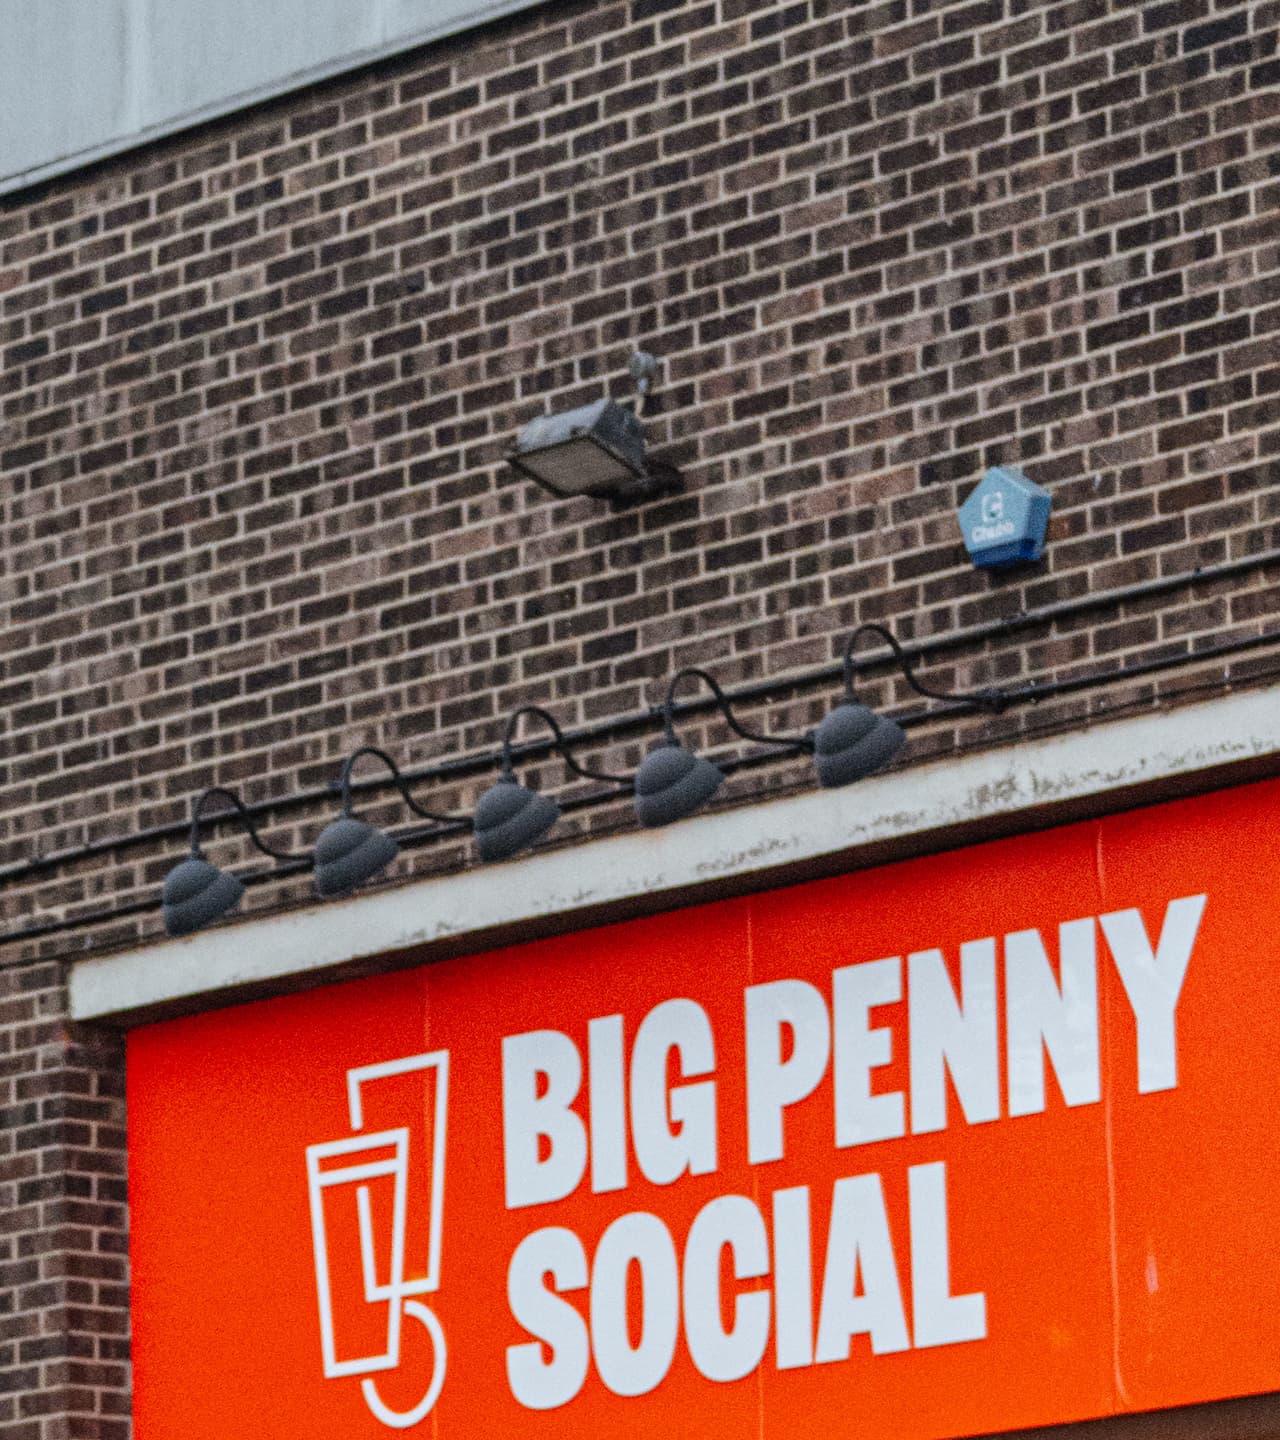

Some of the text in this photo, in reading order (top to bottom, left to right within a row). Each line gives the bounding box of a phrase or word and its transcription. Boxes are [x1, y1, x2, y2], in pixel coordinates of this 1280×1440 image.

[503, 895, 1206, 1208] BIG PENNY
[507, 1162, 986, 1408] SOCIAL
